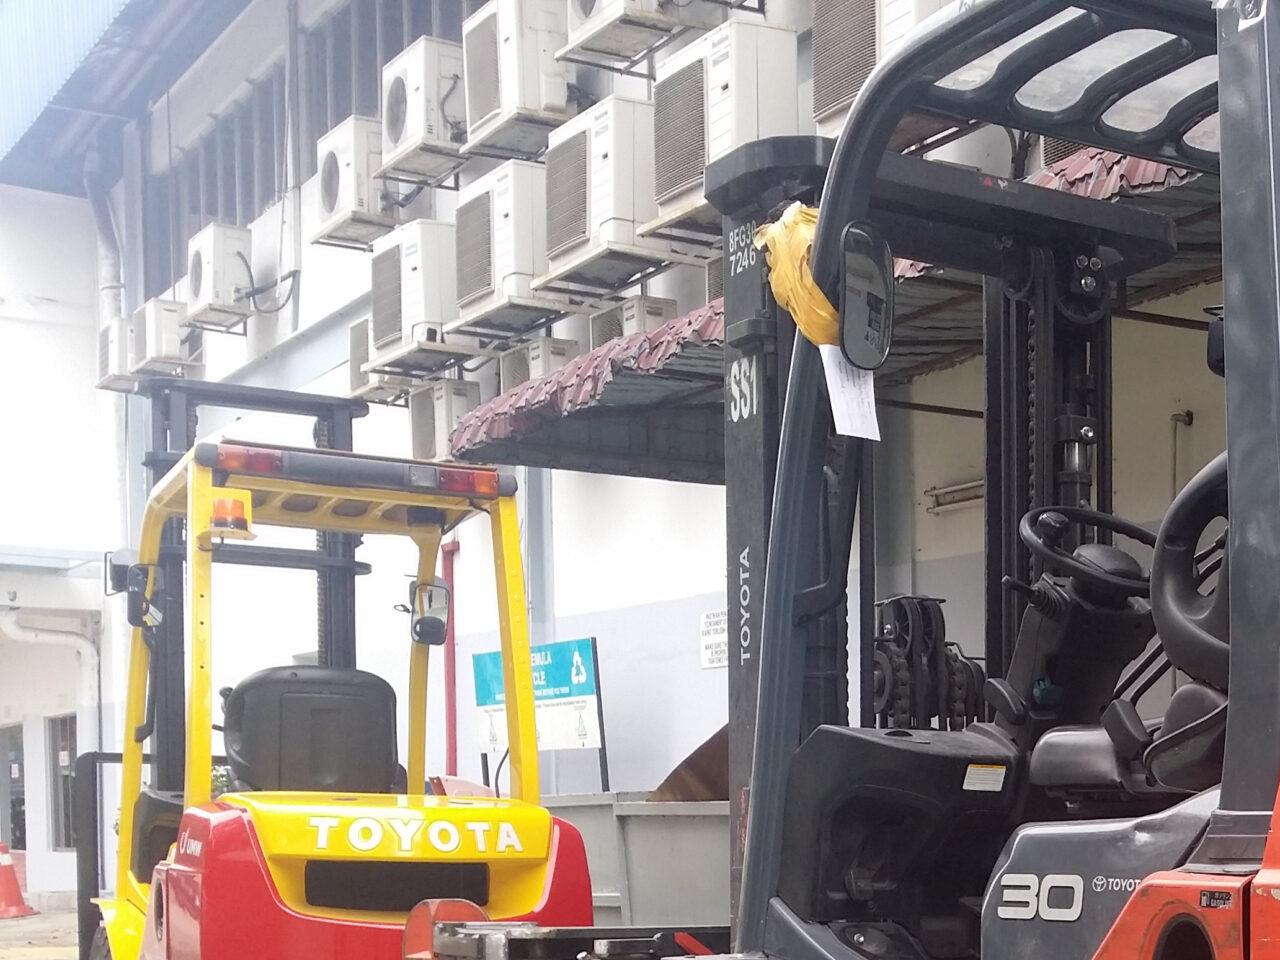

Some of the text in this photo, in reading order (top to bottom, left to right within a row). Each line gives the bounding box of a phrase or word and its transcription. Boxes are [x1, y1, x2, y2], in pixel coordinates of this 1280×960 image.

[729, 243, 756, 277] 7246
[730, 354, 757, 423] SS1
[739, 545, 750, 666] TOYOTA
[530, 650, 552, 666] EMULA
[309, 816, 523, 853] TOYOTA
[997, 873, 1084, 922] 30
[1107, 878, 1142, 893] TOYOT
